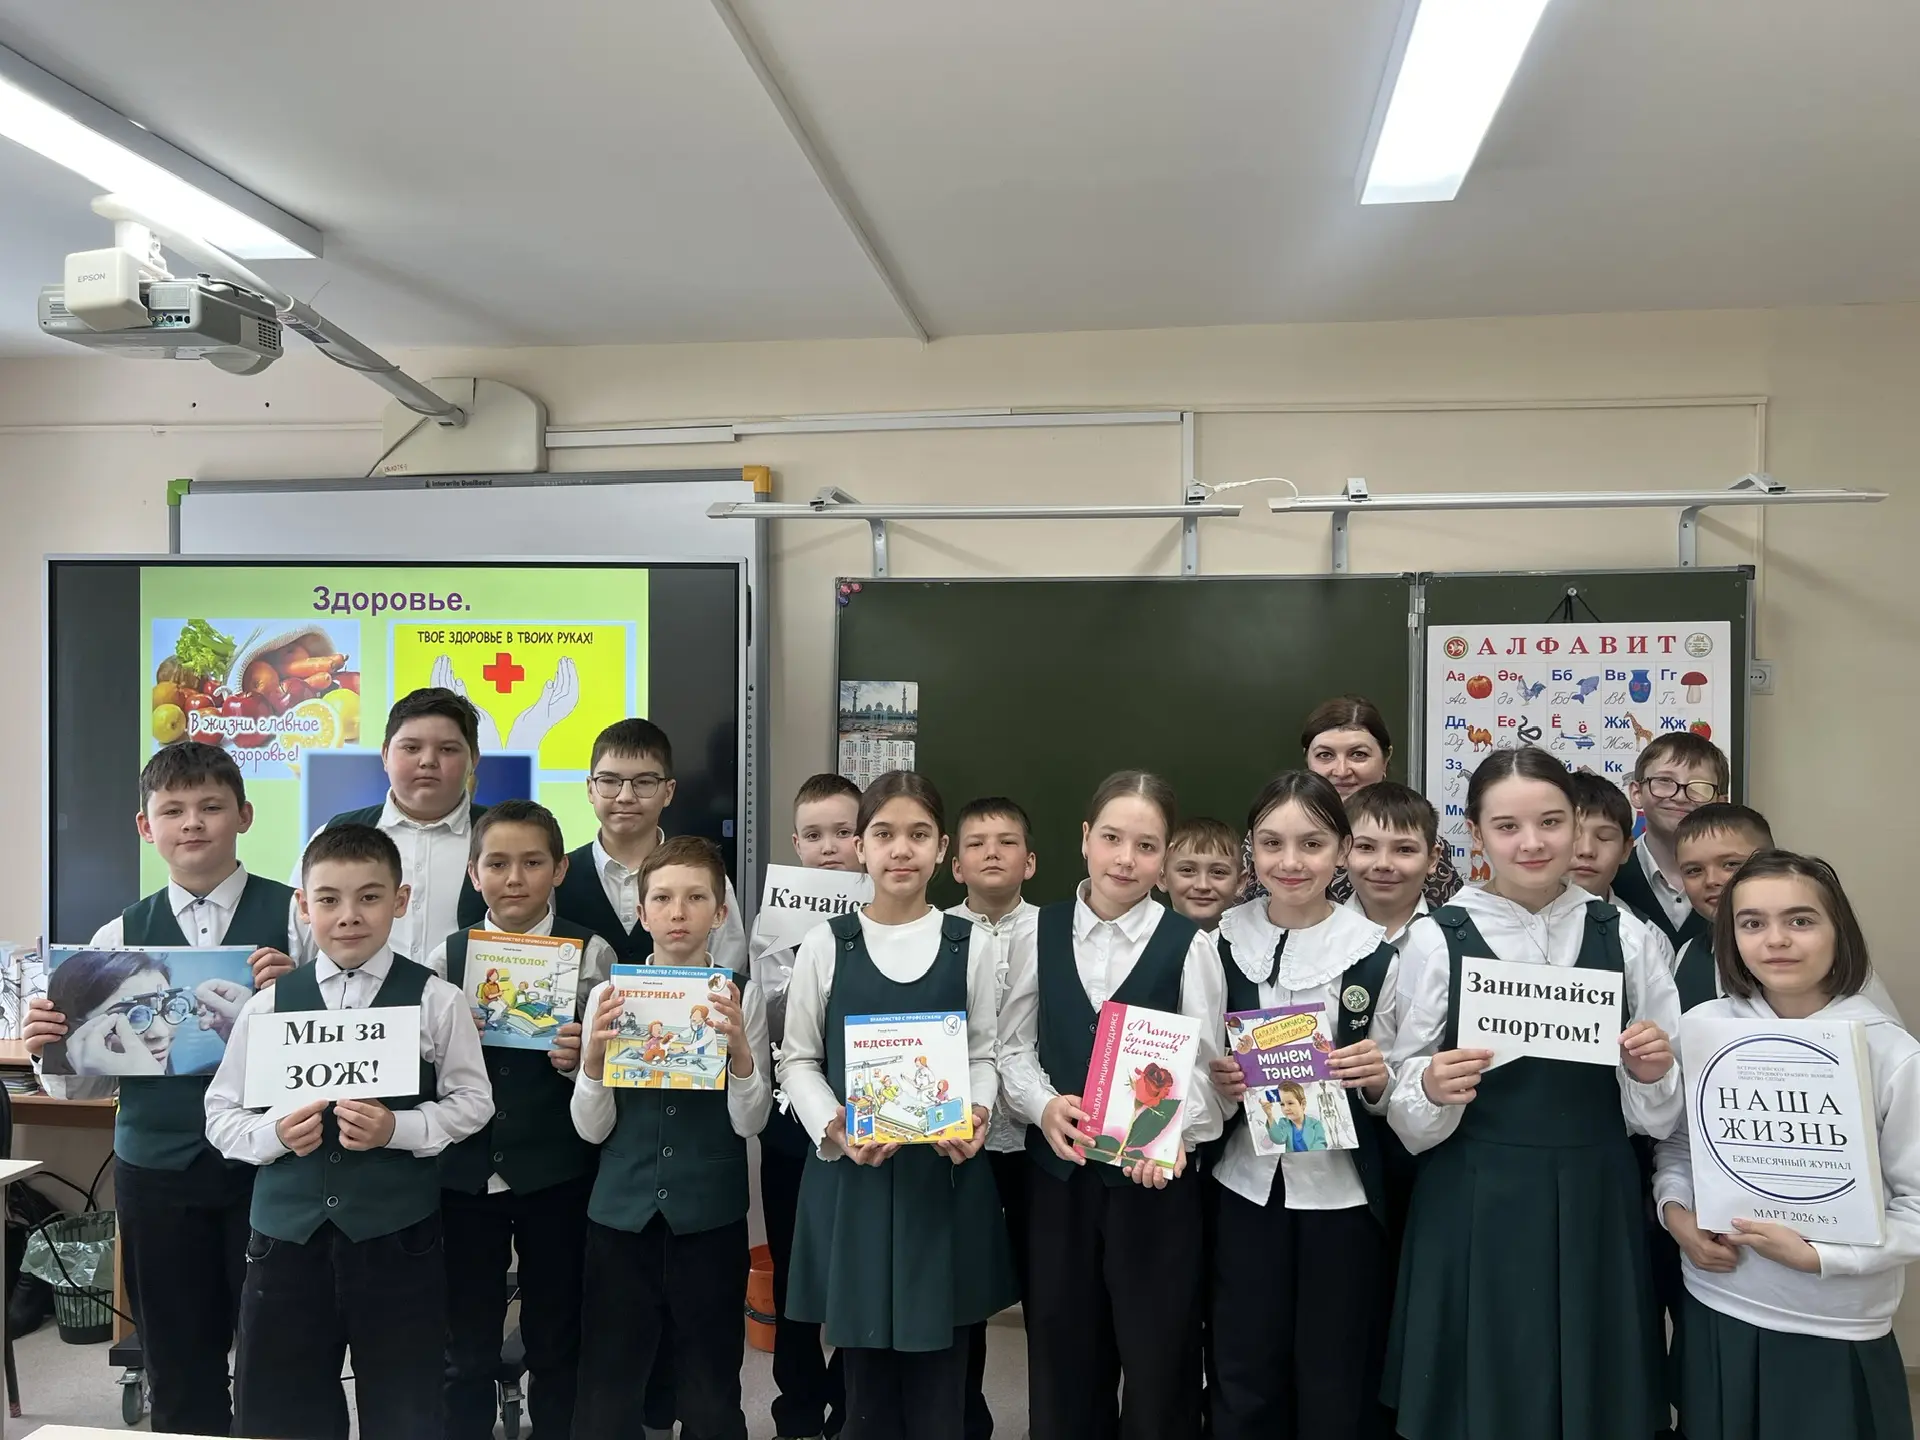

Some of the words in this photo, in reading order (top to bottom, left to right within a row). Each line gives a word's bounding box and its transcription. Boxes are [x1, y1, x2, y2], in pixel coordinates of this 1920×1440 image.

[77, 272, 106, 283] EPSON
[312, 585, 471, 616] Здоровье.
[417, 631, 445, 643] ТВОЕ
[449, 631, 502, 645] ЗДОРОВЬЕ
[507, 631, 513, 643] В
[517, 632, 553, 643] ТВОИХ
[557, 632, 593, 644] РУКАХ!
[1476, 635, 1677, 655] АЛФАВИТ
[1446, 670, 1466, 681] Аа
[1552, 669, 1573, 681] Бб
[1605, 669, 1627, 681] Вв
[1661, 669, 1677, 681] Гг
[190, 712, 200, 733] В
[203, 717, 254, 735] жизни
[258, 711, 319, 732] главное
[1445, 715, 1467, 730] Дд
[1497, 715, 1517, 727] Ее
[1604, 716, 1630, 729] Жж
[231, 742, 299, 772] здоровье!
[1445, 759, 1463, 770] Зз
[1605, 760, 1623, 772] Кк
[475, 953, 548, 967] СТОМАТОЛОГ
[618, 989, 686, 1000] ВЕТЕРИНАР
[1466, 971, 1616, 1006] Занимайся
[283, 1020, 345, 1046] Мы
[354, 1022, 386, 1041] за
[1127, 1019, 1191, 1046] Матур
[1477, 1016, 1600, 1044] спортом!
[1822, 1032, 1835, 1040] 12+
[853, 1037, 923, 1049] МЕДСЕСТРА
[285, 1060, 379, 1090] ЗОЖ!
[1091, 1086, 1104, 1120] КЫЗЛАР
[1099, 1012, 1119, 1086] ЭНЦИКЛОПЕДИЯСЕ
[1718, 1086, 1843, 1115] НАША
[1719, 1117, 1848, 1146] ЖИЗНЬ
[1732, 1155, 1807, 1168] ЕЖЕМЕСЯЧНЫЙ
[1808, 1159, 1852, 1170] ЖУРНАЛ
[1753, 1208, 1788, 1220] МАРТ
[1791, 1212, 1815, 1223] 2026
[1817, 1215, 1829, 1225] №
[1832, 1216, 1838, 1225] 3
